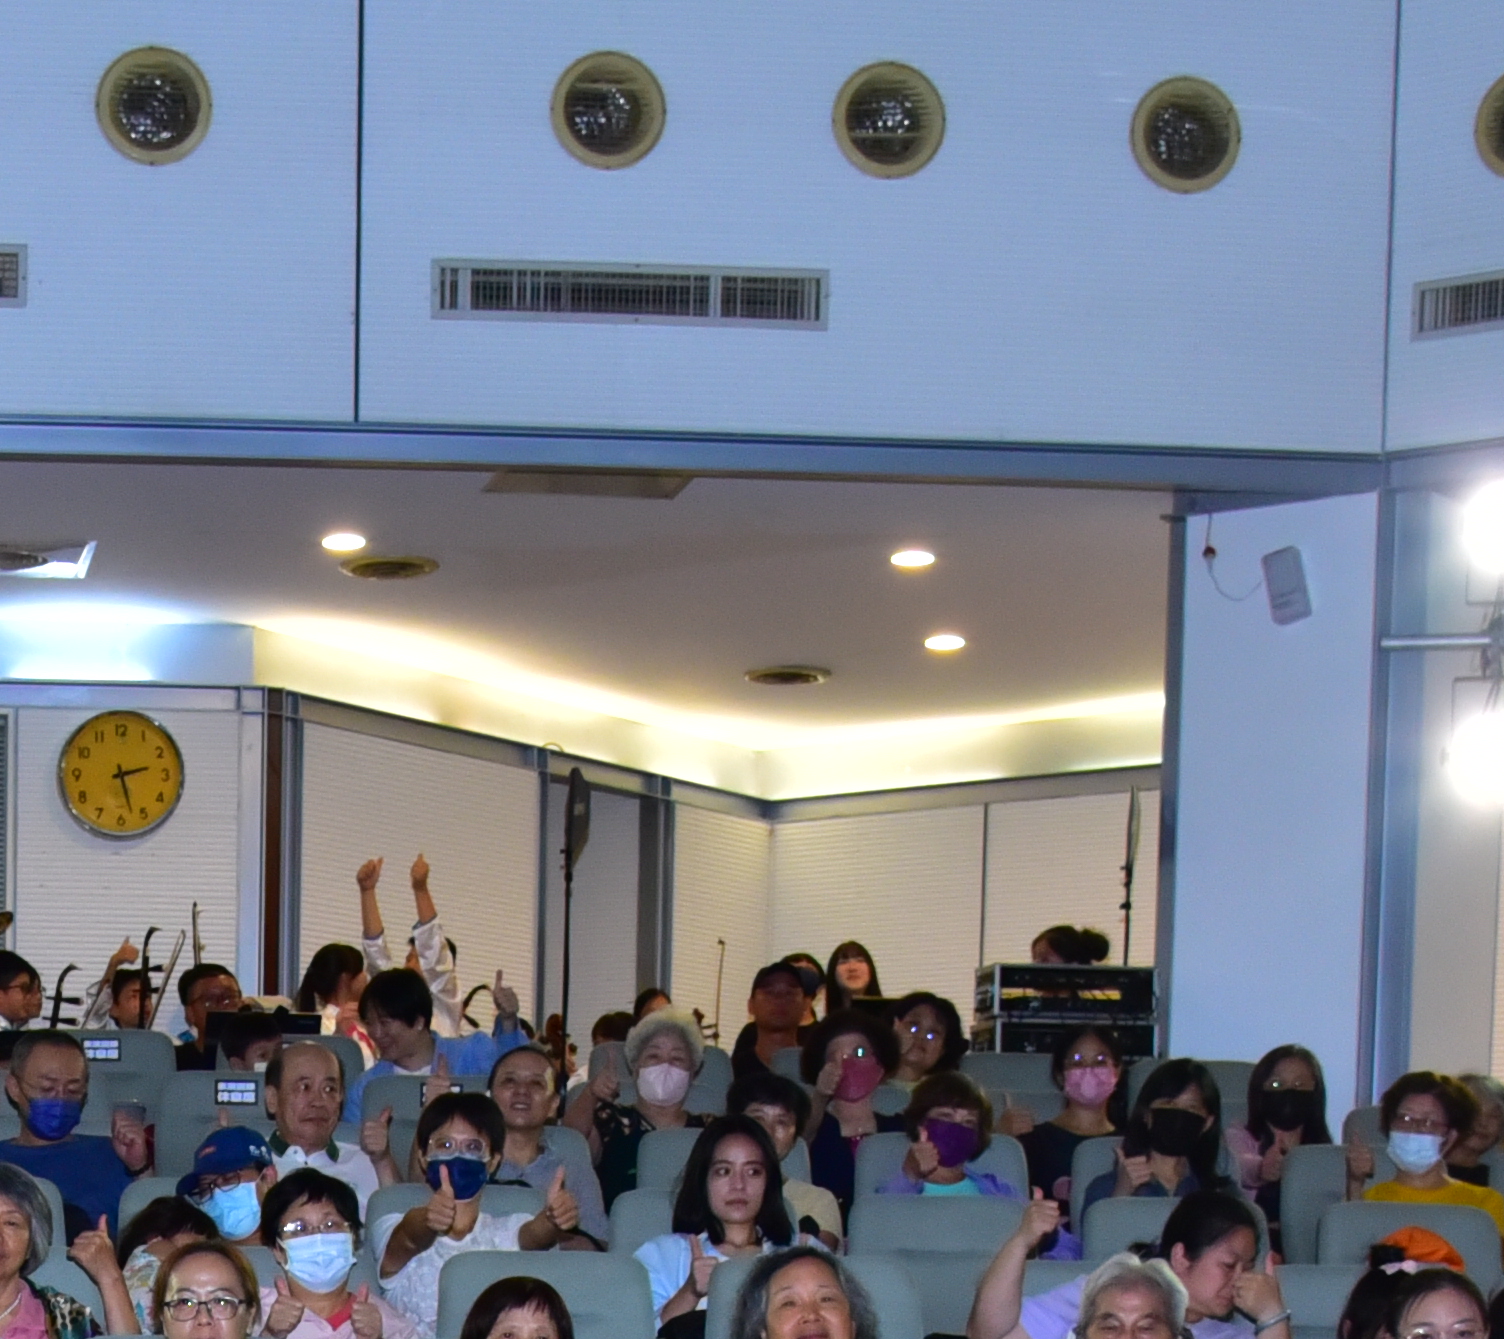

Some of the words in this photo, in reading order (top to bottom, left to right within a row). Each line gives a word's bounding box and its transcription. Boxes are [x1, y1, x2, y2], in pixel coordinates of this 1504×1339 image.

[94, 729, 105, 743] 11
[114, 723, 128, 737] 12
[141, 729, 146, 742] 1
[78, 746, 91, 759] 10
[154, 745, 164, 759] 2
[71, 767, 82, 782] 9
[160, 767, 170, 782] 3
[77, 790, 87, 804] 8
[155, 791, 165, 803] 4
[94, 806, 104, 820] 7
[116, 814, 126, 826] 6
[139, 806, 149, 820] 5
